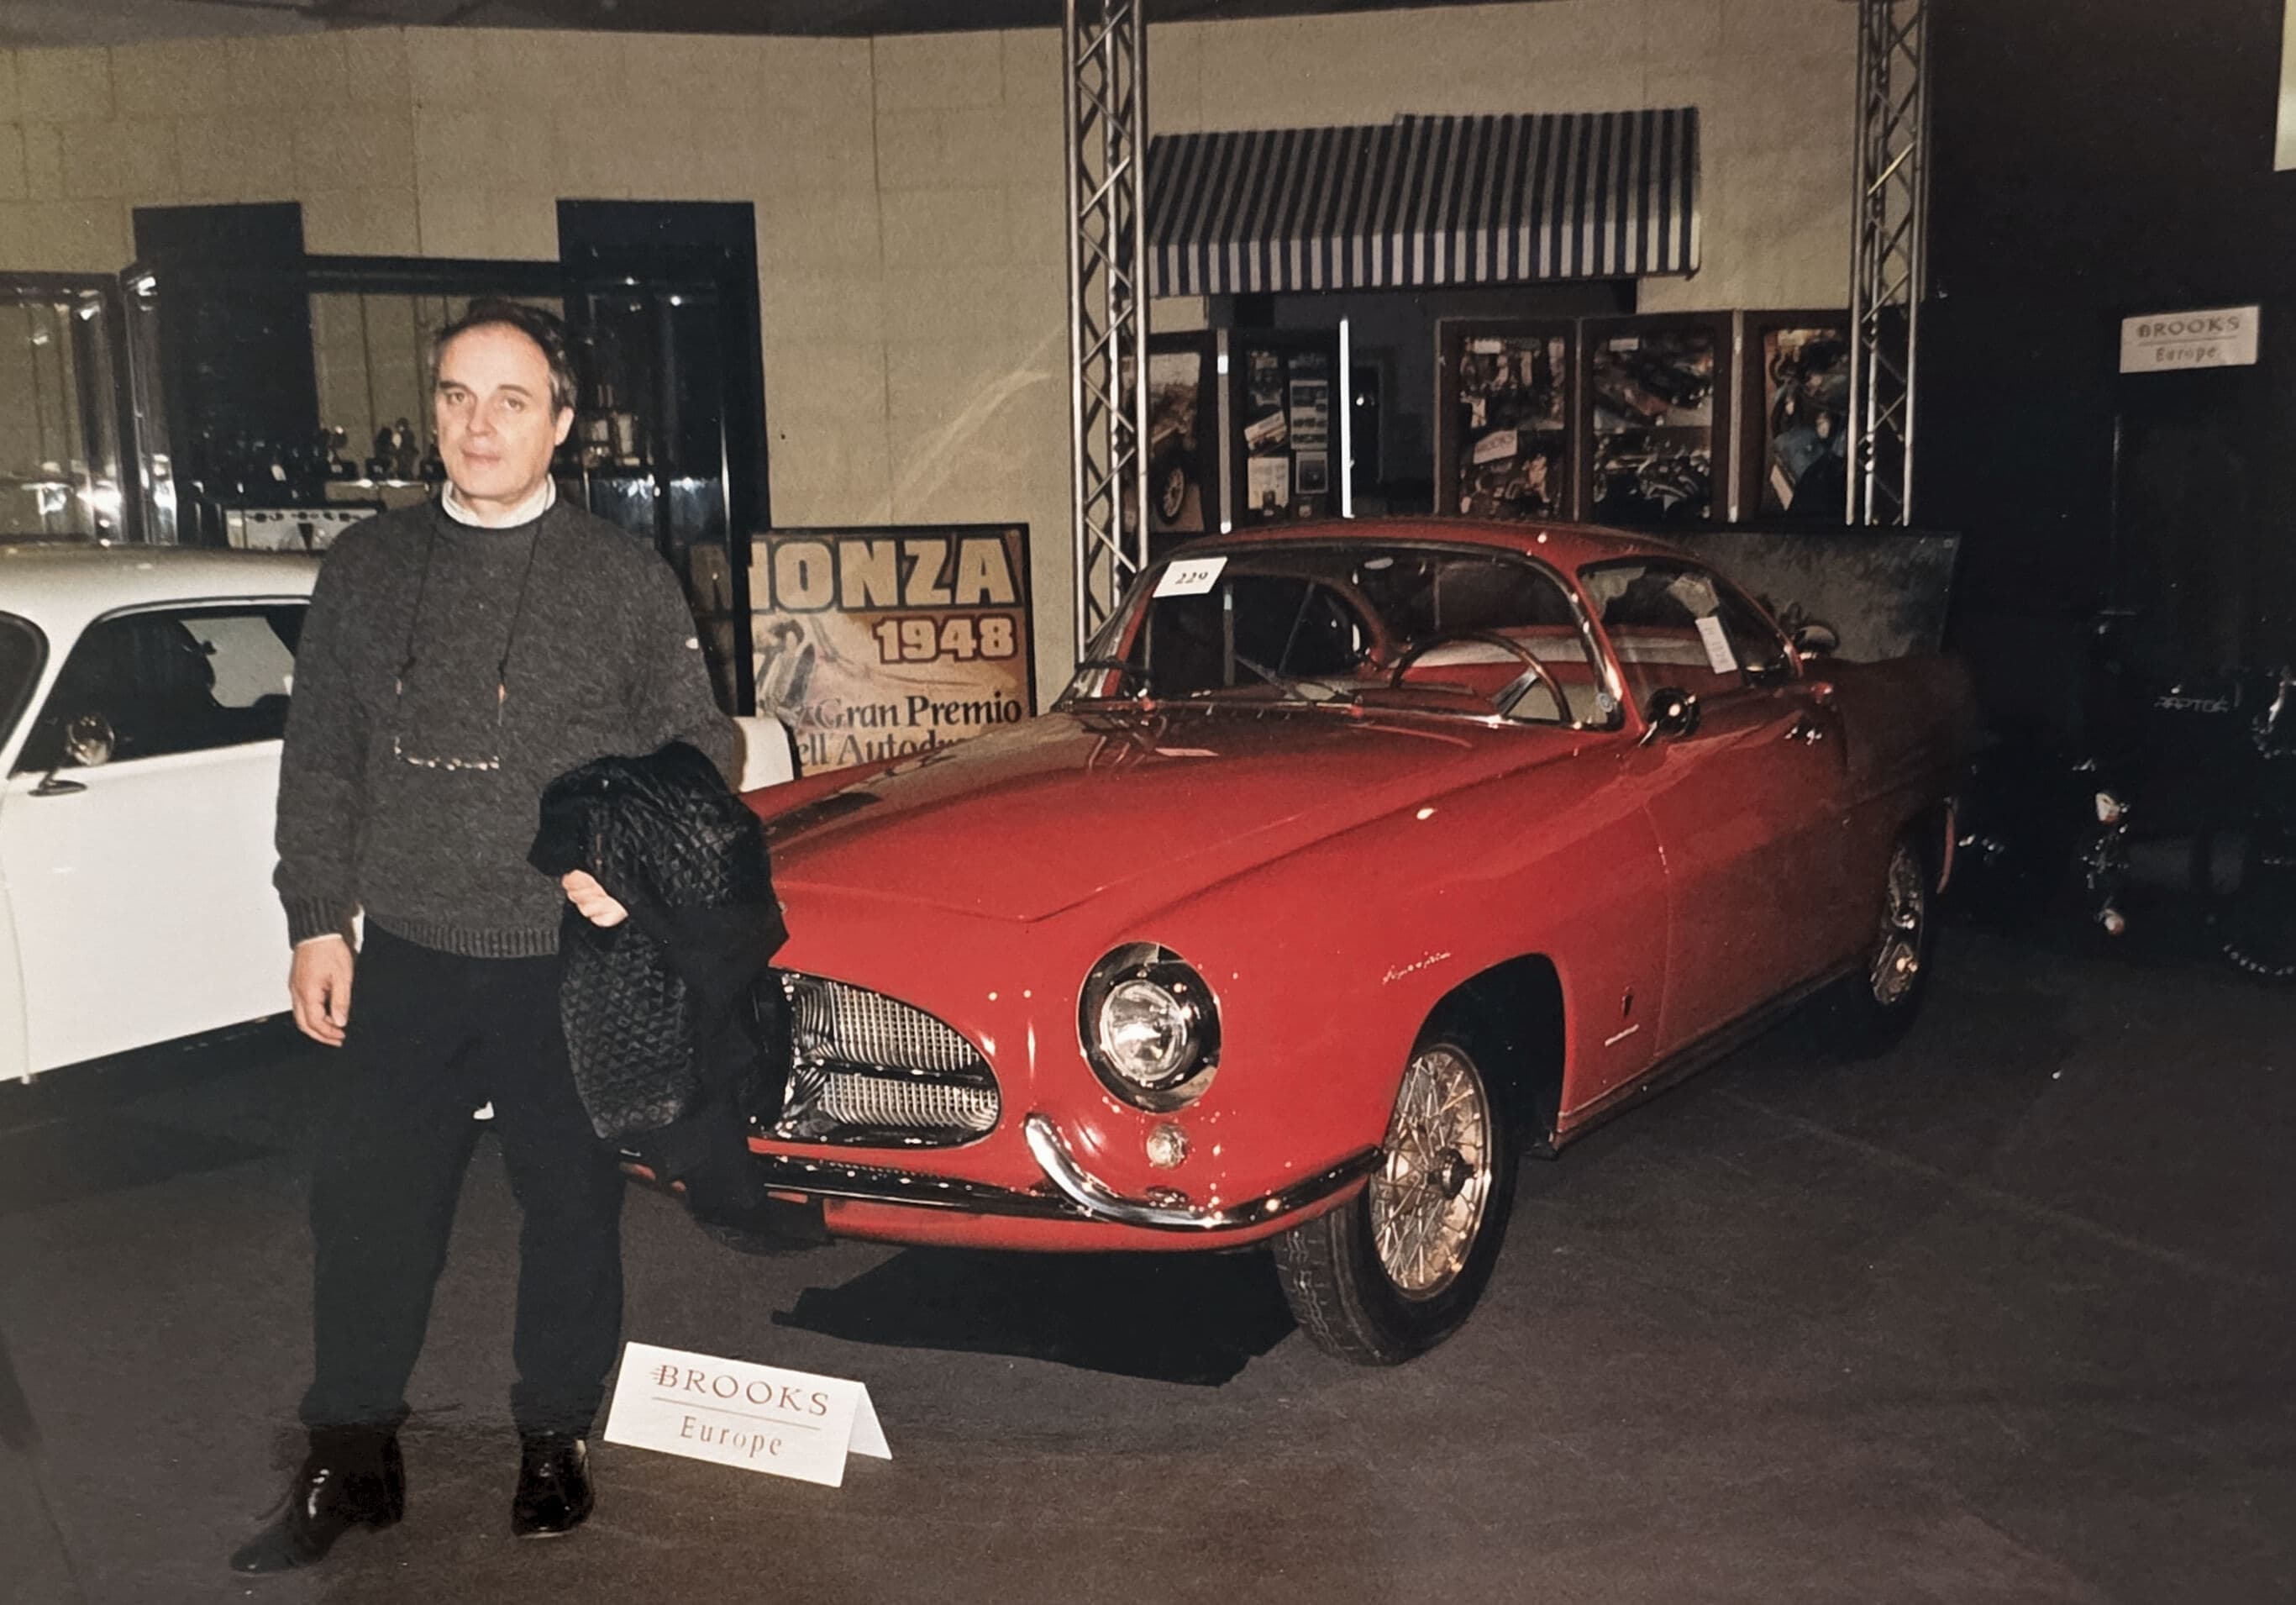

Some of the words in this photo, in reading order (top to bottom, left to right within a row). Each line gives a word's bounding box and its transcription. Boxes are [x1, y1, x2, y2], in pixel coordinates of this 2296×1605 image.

[2137, 316, 2240, 338] BROOKS
[2156, 347, 2218, 363] Europe
[1175, 571, 1209, 584] 229
[875, 617, 1016, 661] 1948
[815, 699, 899, 728] Gran
[906, 691, 1022, 724] Premio
[652, 1365, 828, 1416] BROOKS
[680, 1416, 782, 1457] Europe
